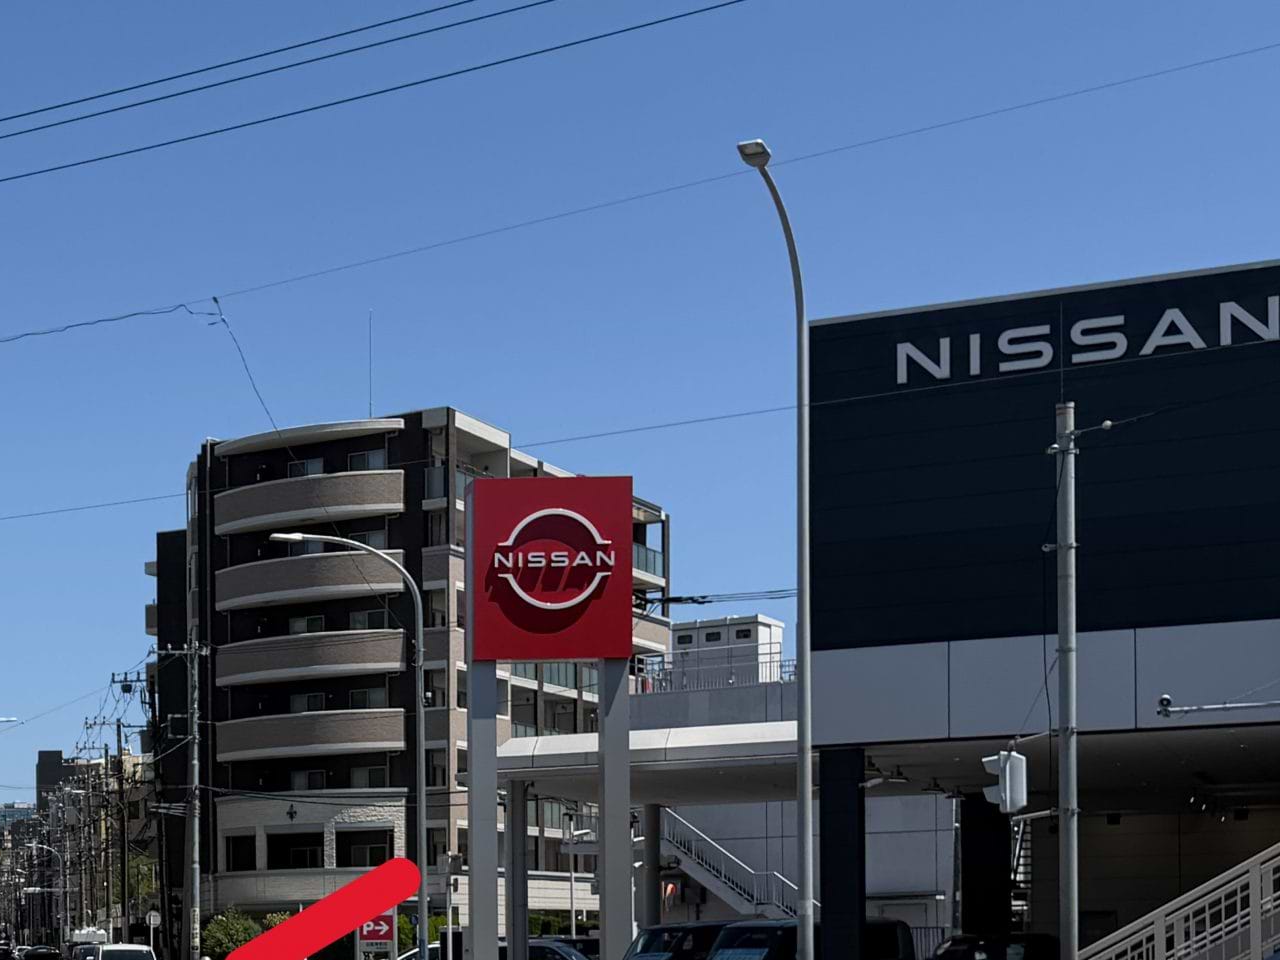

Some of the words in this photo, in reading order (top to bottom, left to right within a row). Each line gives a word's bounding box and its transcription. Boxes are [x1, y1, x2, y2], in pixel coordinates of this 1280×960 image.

[896, 294, 1280, 385] NISSAN
[493, 550, 616, 568] NISSAN
[362, 921, 375, 935] P
